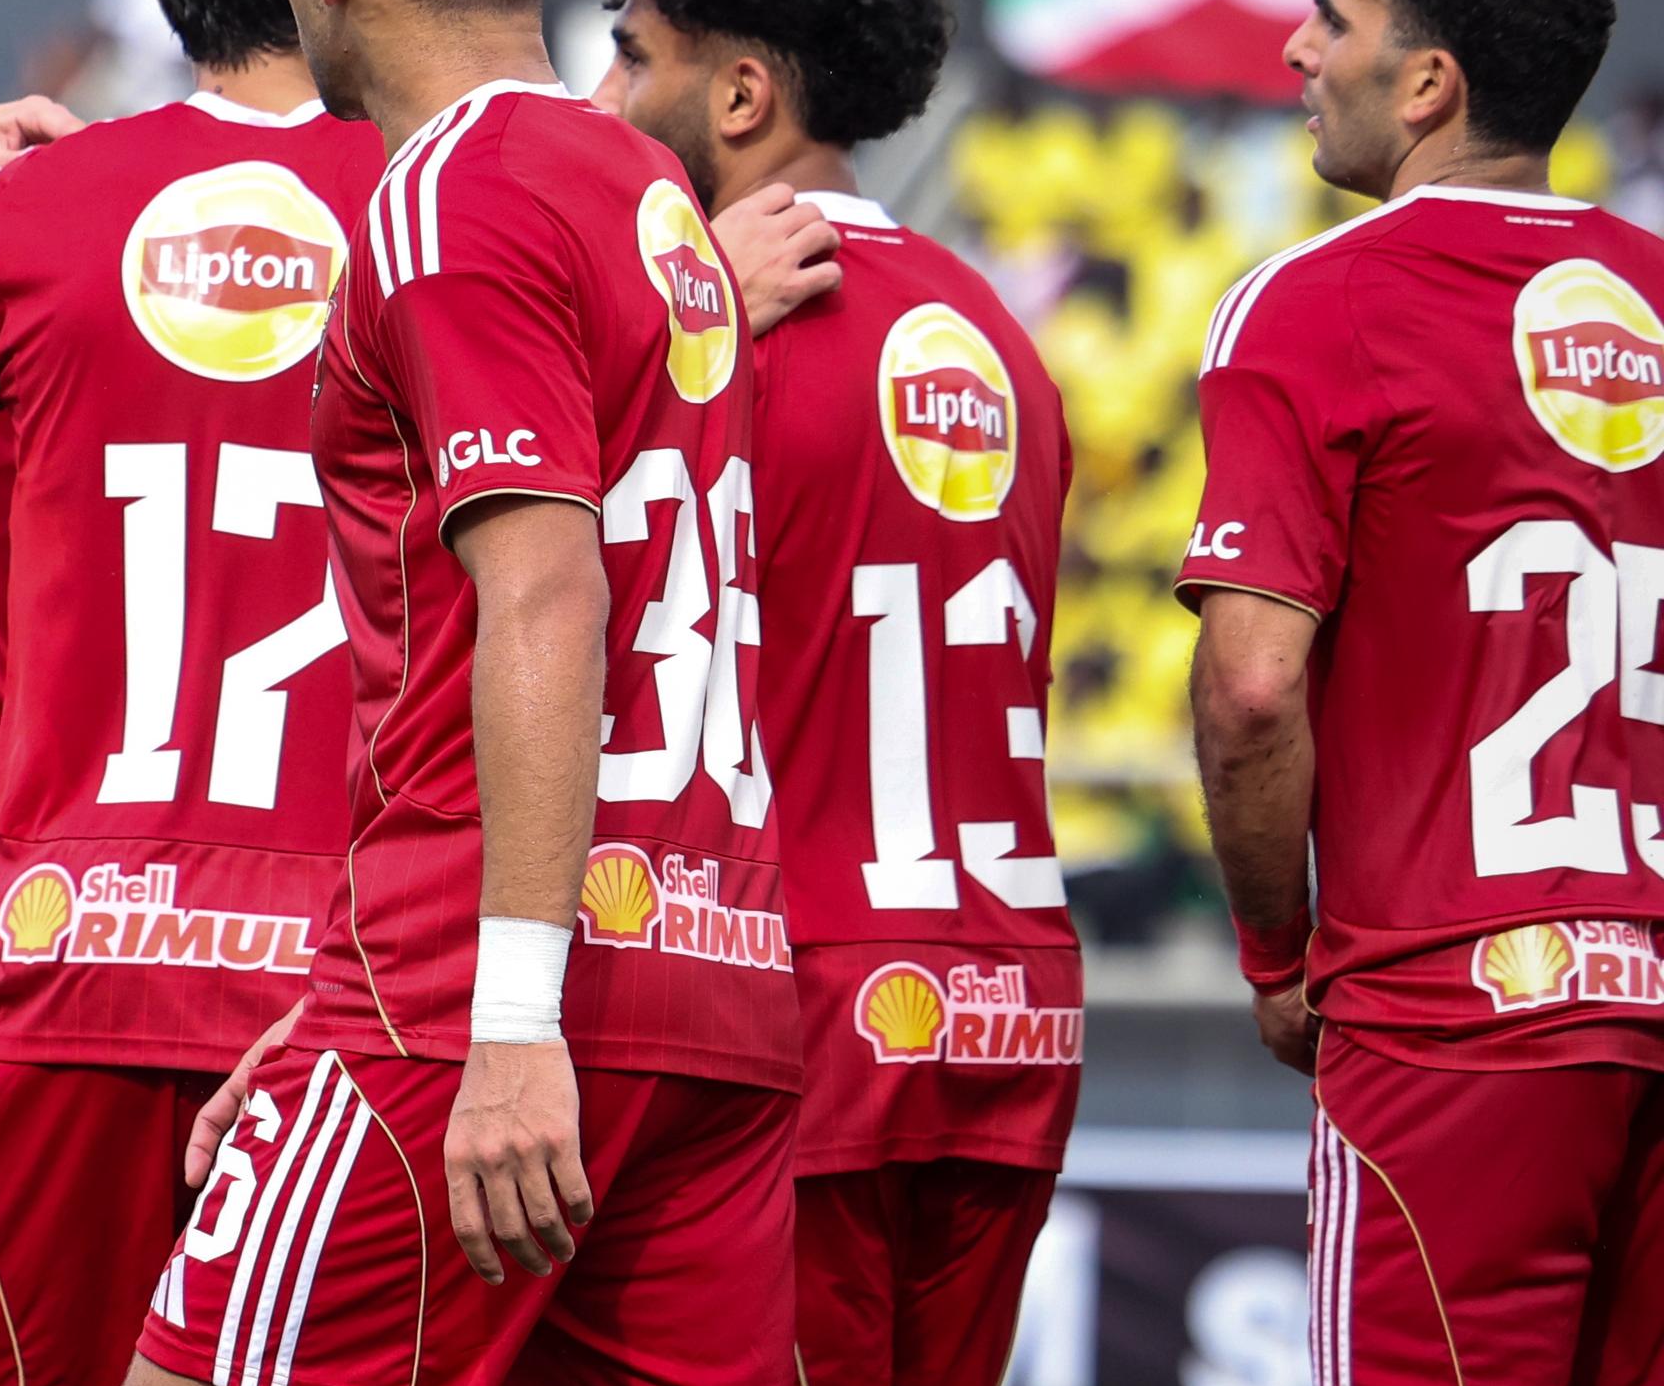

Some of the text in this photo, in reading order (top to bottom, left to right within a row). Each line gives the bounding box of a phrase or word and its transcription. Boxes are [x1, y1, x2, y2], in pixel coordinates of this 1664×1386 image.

[156, 242, 315, 295] Lipton
[1541, 335, 1662, 387] Lipton
[904, 381, 1003, 439] Lipton
[447, 427, 543, 471] GLC
[95, 442, 349, 810] 17
[852, 558, 1068, 910] 13
[85, 867, 172, 905] Shell
[665, 858, 718, 902] Shell
[951, 969, 1019, 1005] Shell
